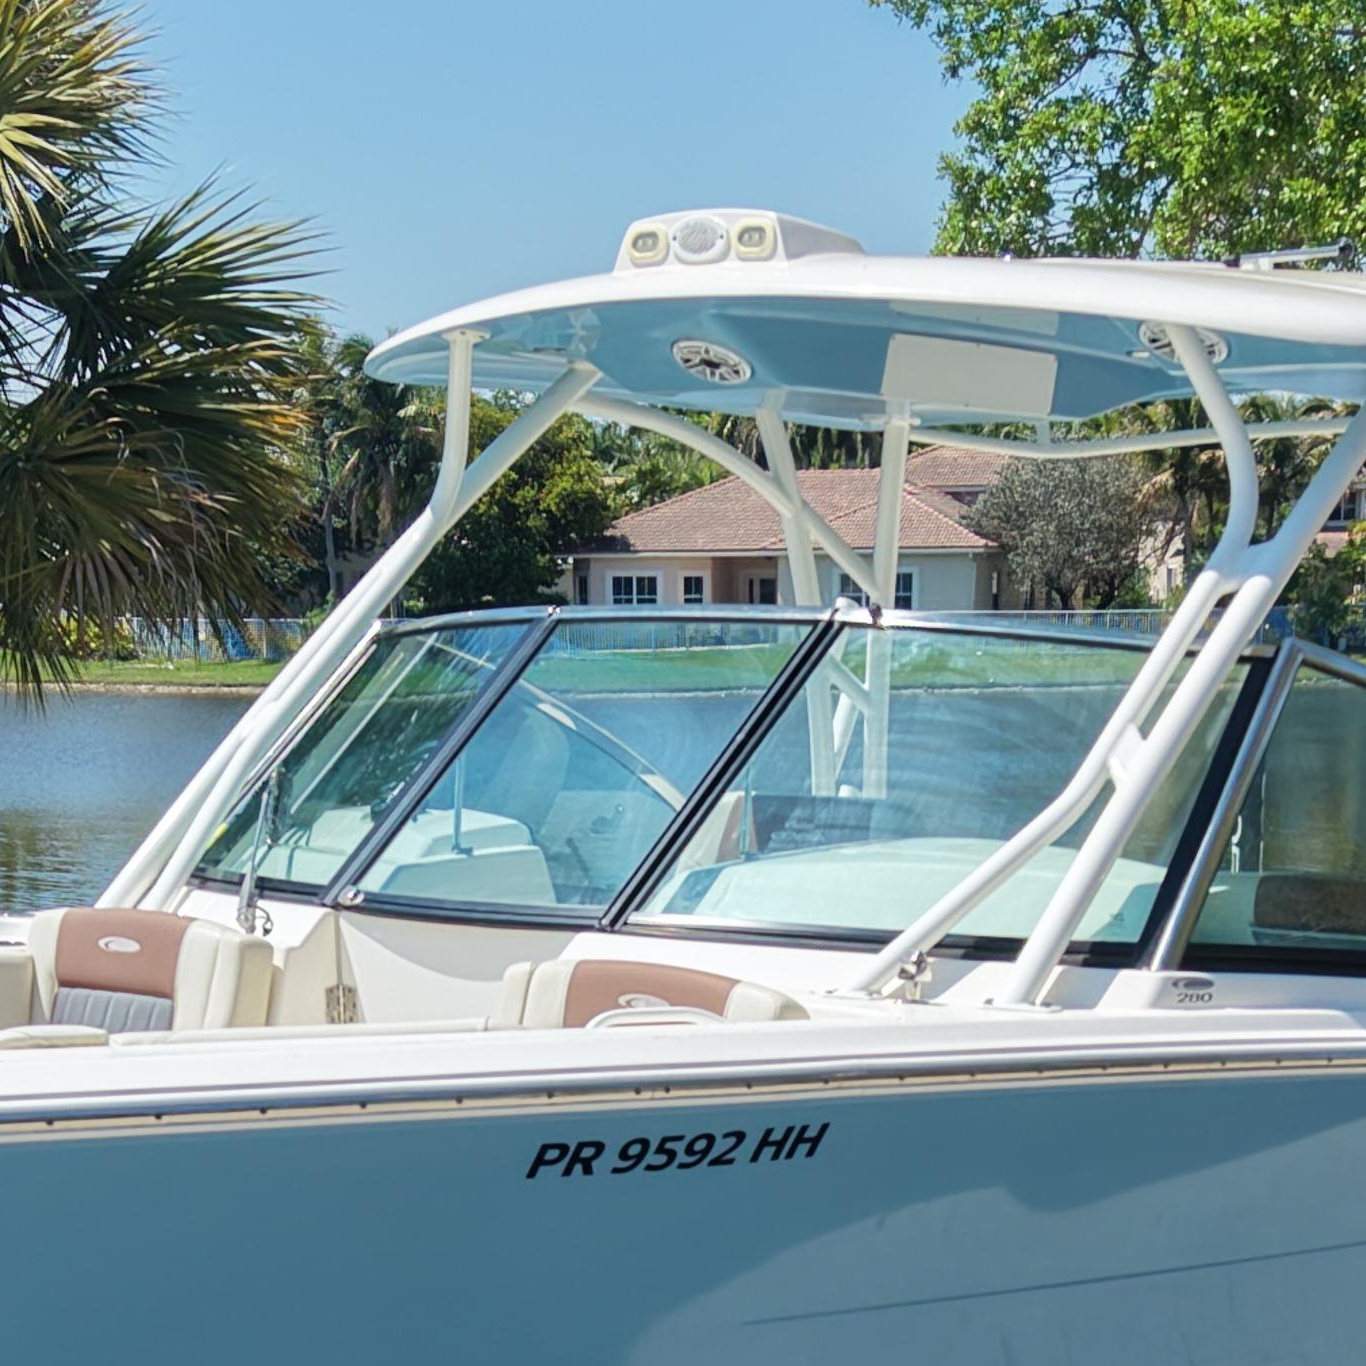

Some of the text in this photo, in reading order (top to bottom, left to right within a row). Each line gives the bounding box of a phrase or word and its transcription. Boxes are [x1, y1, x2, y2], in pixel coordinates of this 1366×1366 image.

[525, 1121, 831, 1180] PR 9592 HH
